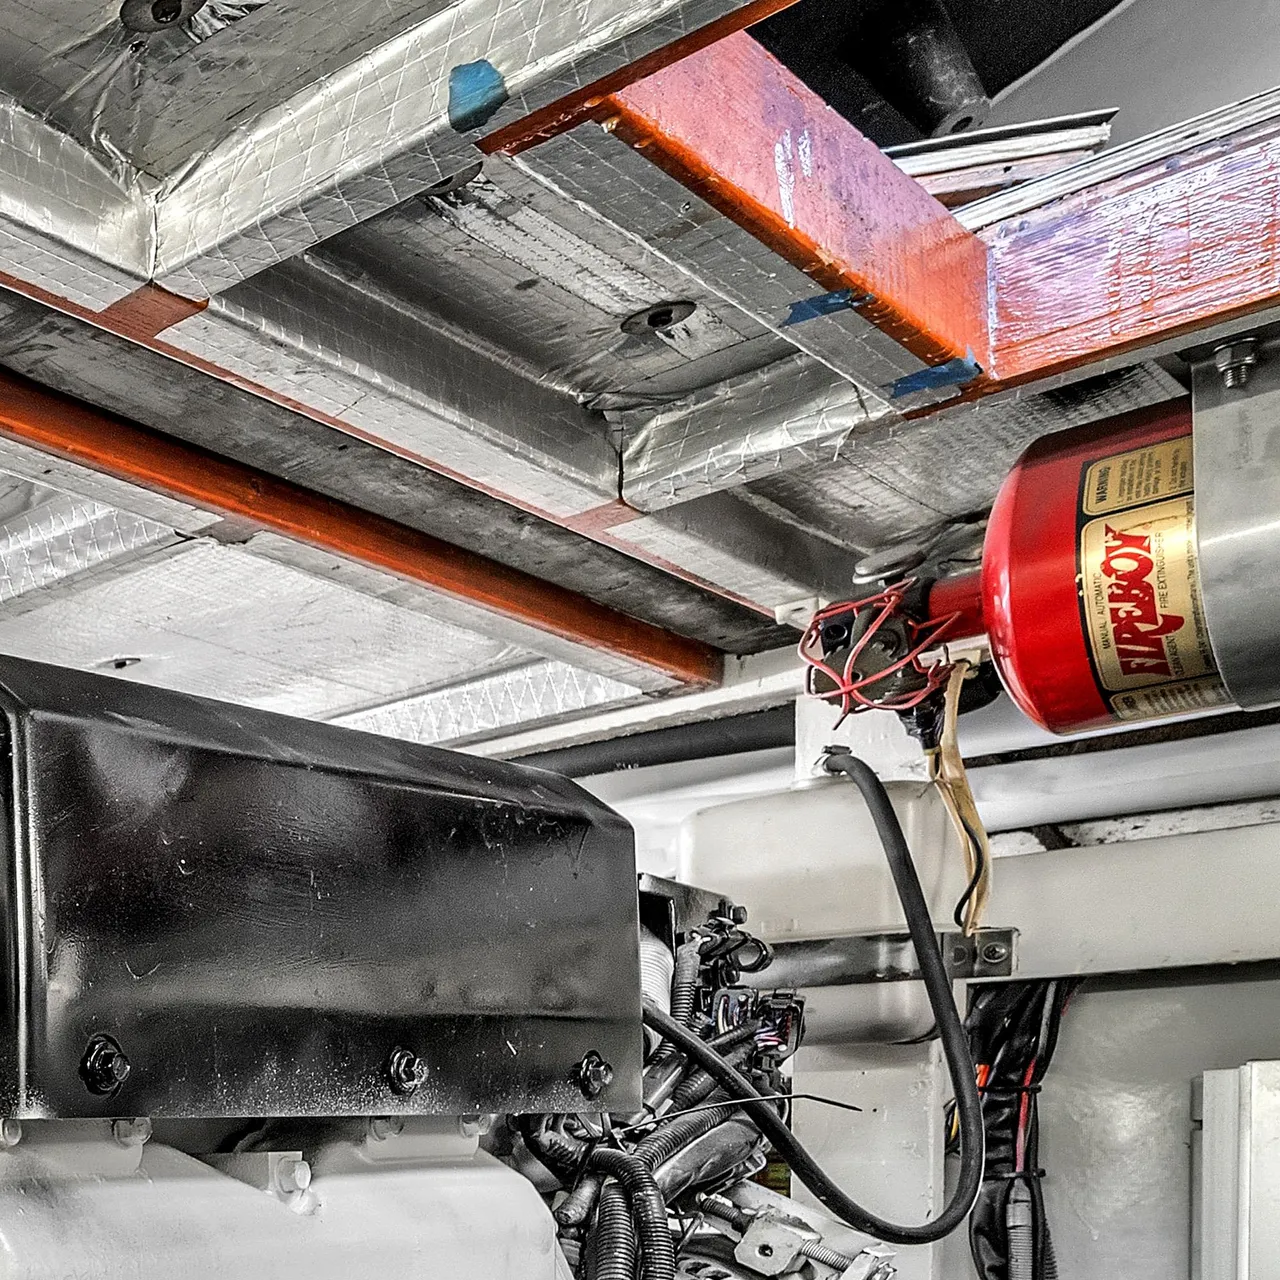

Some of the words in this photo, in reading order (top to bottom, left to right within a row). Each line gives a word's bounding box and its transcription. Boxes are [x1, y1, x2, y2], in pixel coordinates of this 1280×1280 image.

[1095, 467, 1111, 504] WARNING
[1093, 573, 1105, 616] AUTOMATIC
[1100, 523, 1184, 676] FIREBOY
[1159, 592, 1168, 608] FIRE
[1095, 621, 1110, 649] MANUAL
[1166, 636, 1178, 656] AGENT
